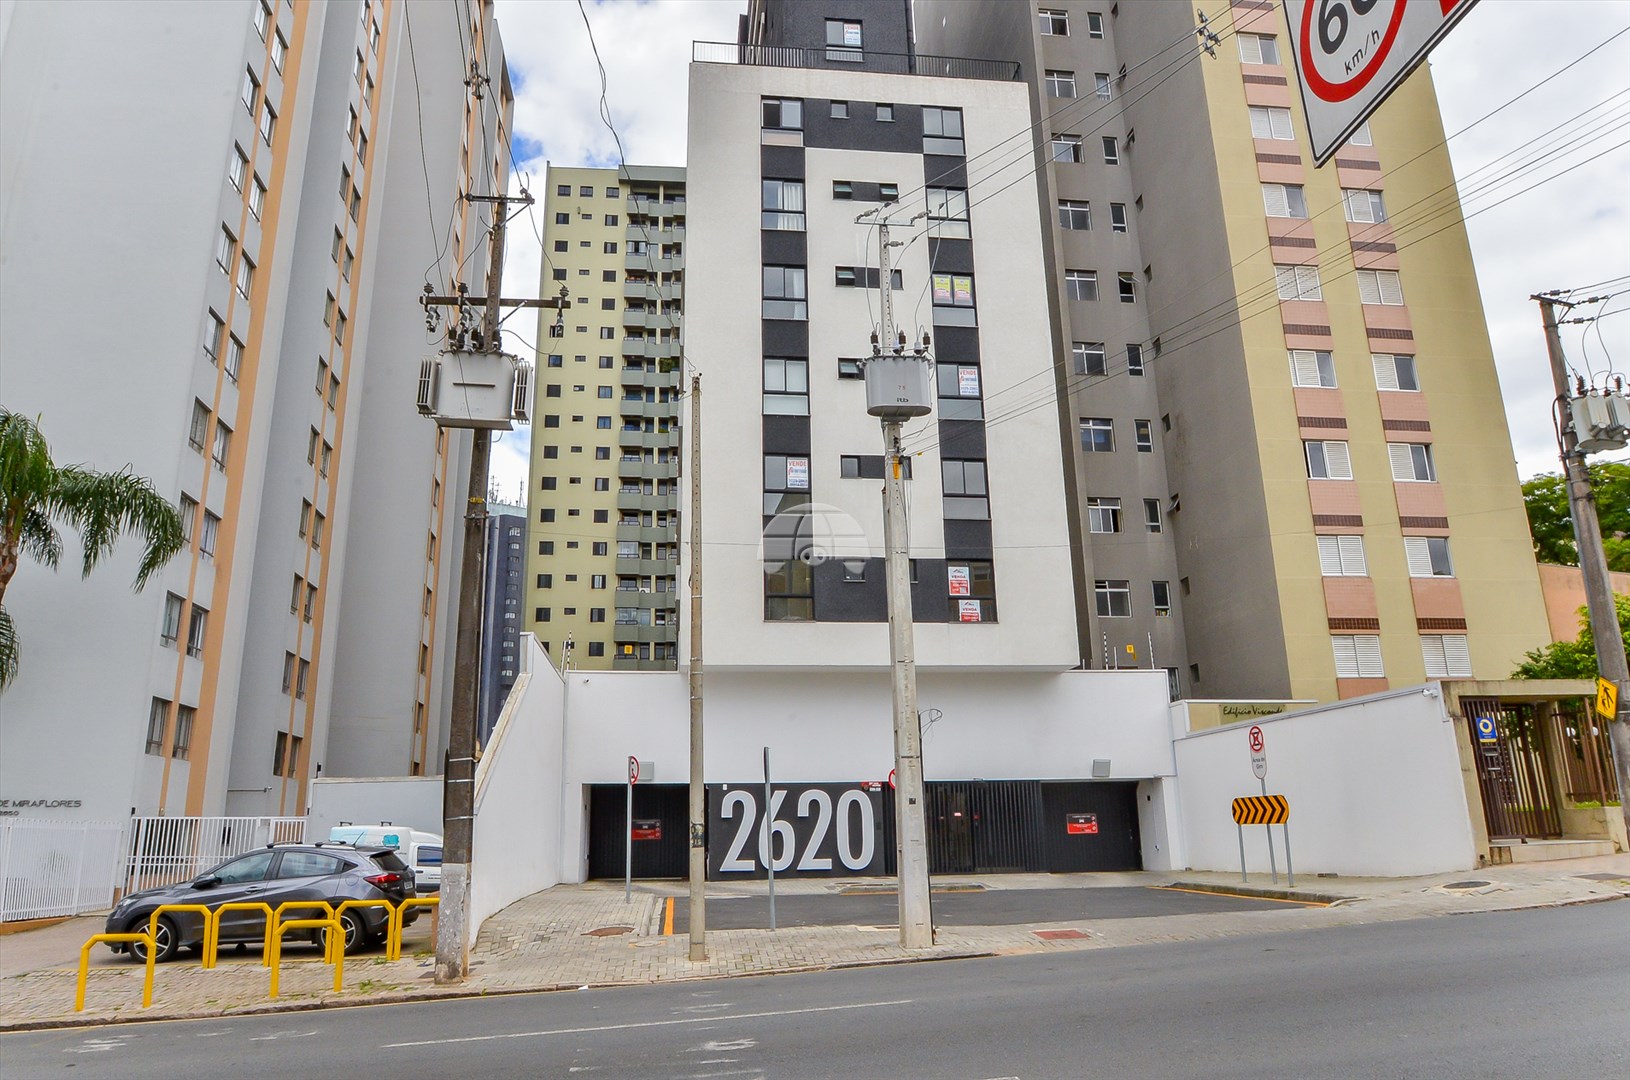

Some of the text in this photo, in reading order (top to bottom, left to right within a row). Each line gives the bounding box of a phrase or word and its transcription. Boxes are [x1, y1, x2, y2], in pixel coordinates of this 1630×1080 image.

[1318, 0, 1378, 54] 6
[1343, 29, 1381, 75] km/h
[12, 799, 82, 808] MIRAFLORES
[719, 788, 876, 872] 2620
